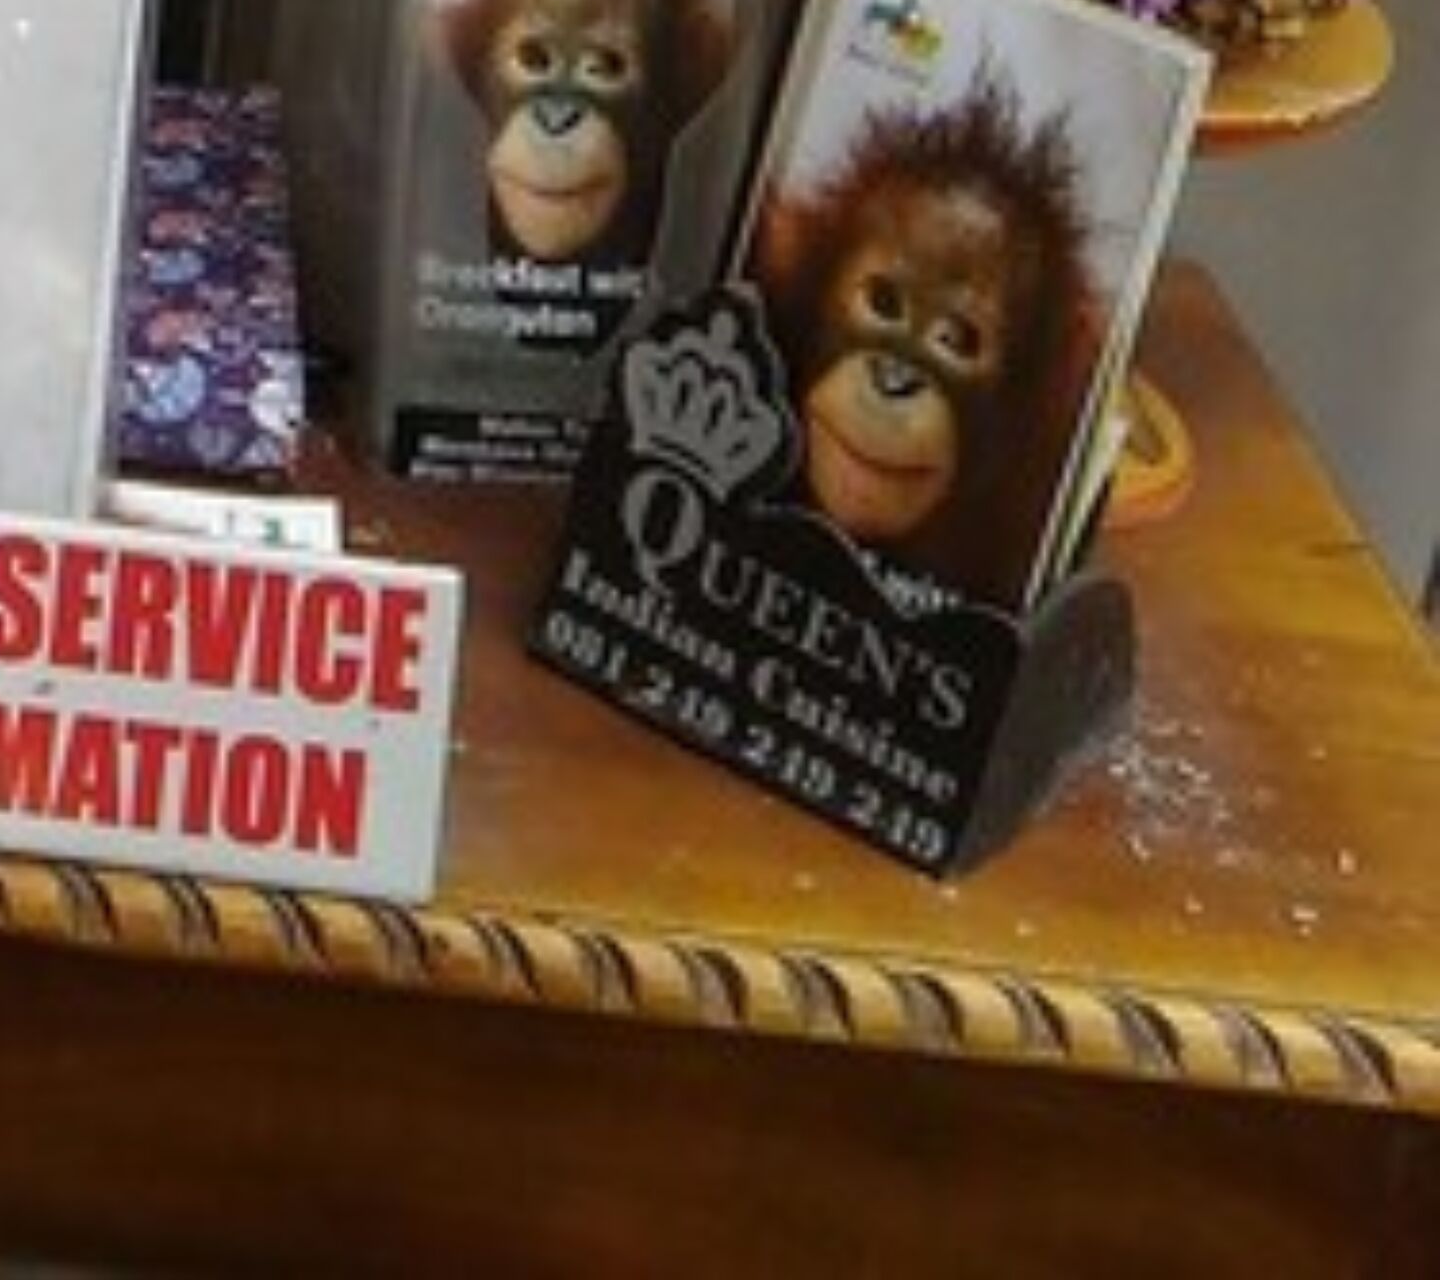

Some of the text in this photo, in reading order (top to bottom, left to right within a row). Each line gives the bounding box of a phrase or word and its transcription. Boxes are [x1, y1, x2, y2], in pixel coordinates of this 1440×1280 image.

[562, 546, 738, 684] Indian
[748, 653, 960, 804] Cuisine
[623, 470, 972, 728] QUEEN'S
